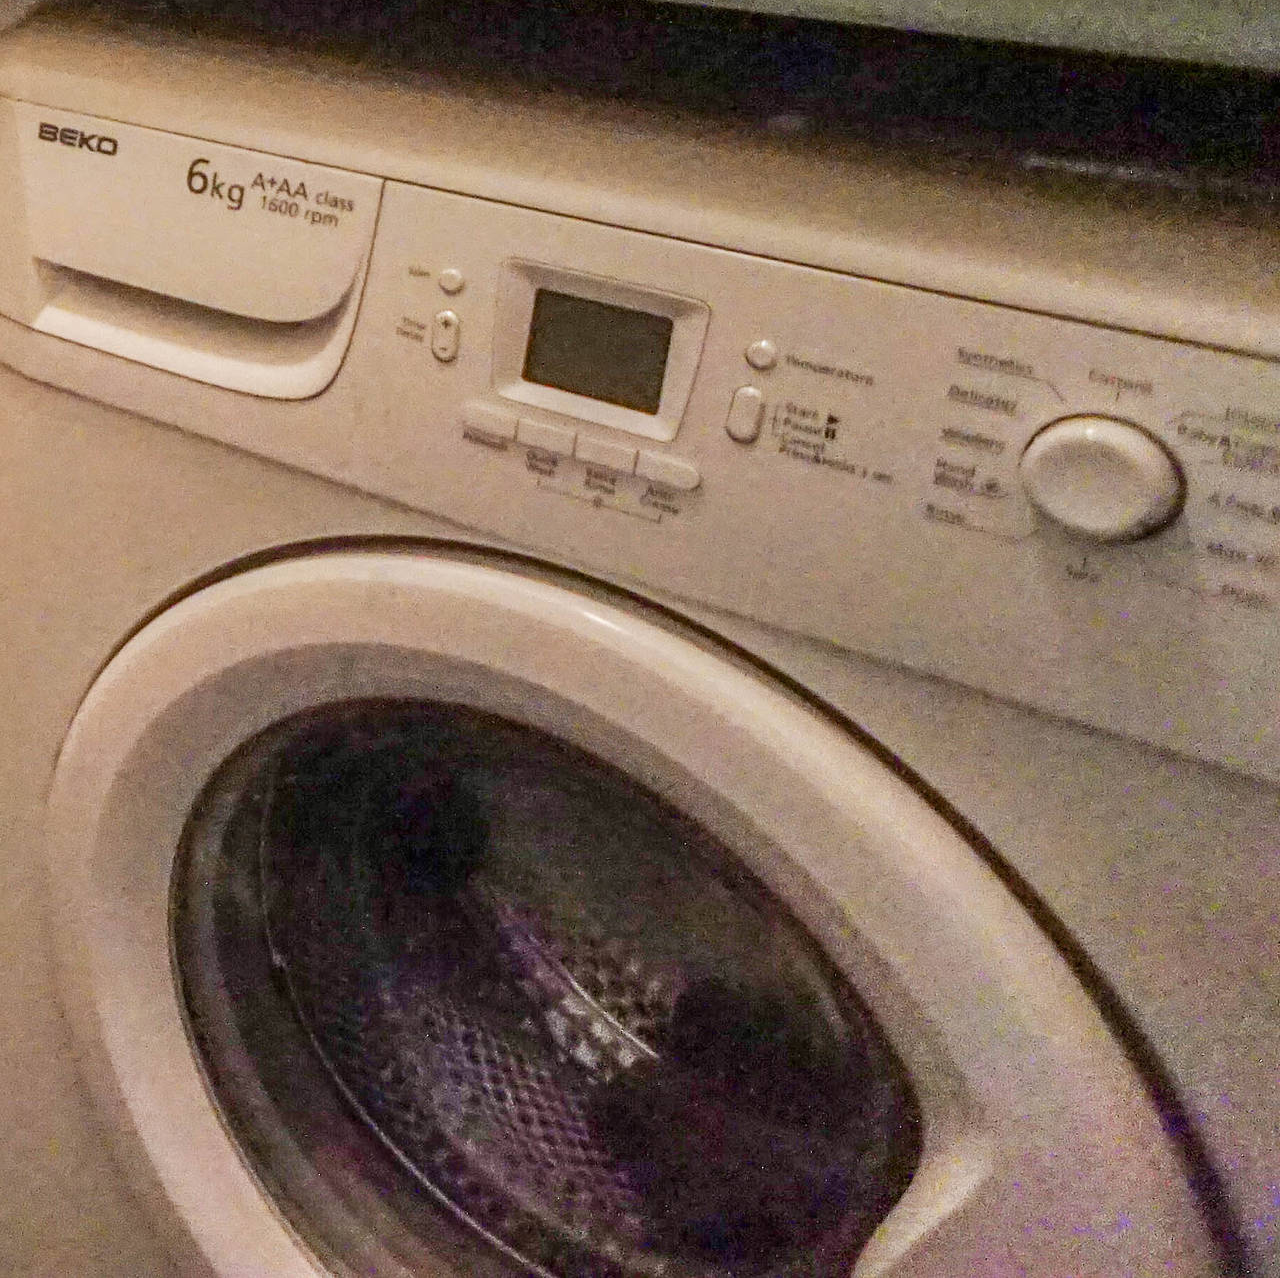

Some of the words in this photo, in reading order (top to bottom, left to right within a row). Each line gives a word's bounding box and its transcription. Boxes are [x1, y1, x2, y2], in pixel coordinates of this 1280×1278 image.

[38, 122, 118, 156] BEKO
[186, 158, 245, 211] 6kg
[251, 172, 308, 201] A+AA
[315, 190, 356, 212] class
[260, 195, 299, 218] 1600
[304, 209, 339, 227] rpm
